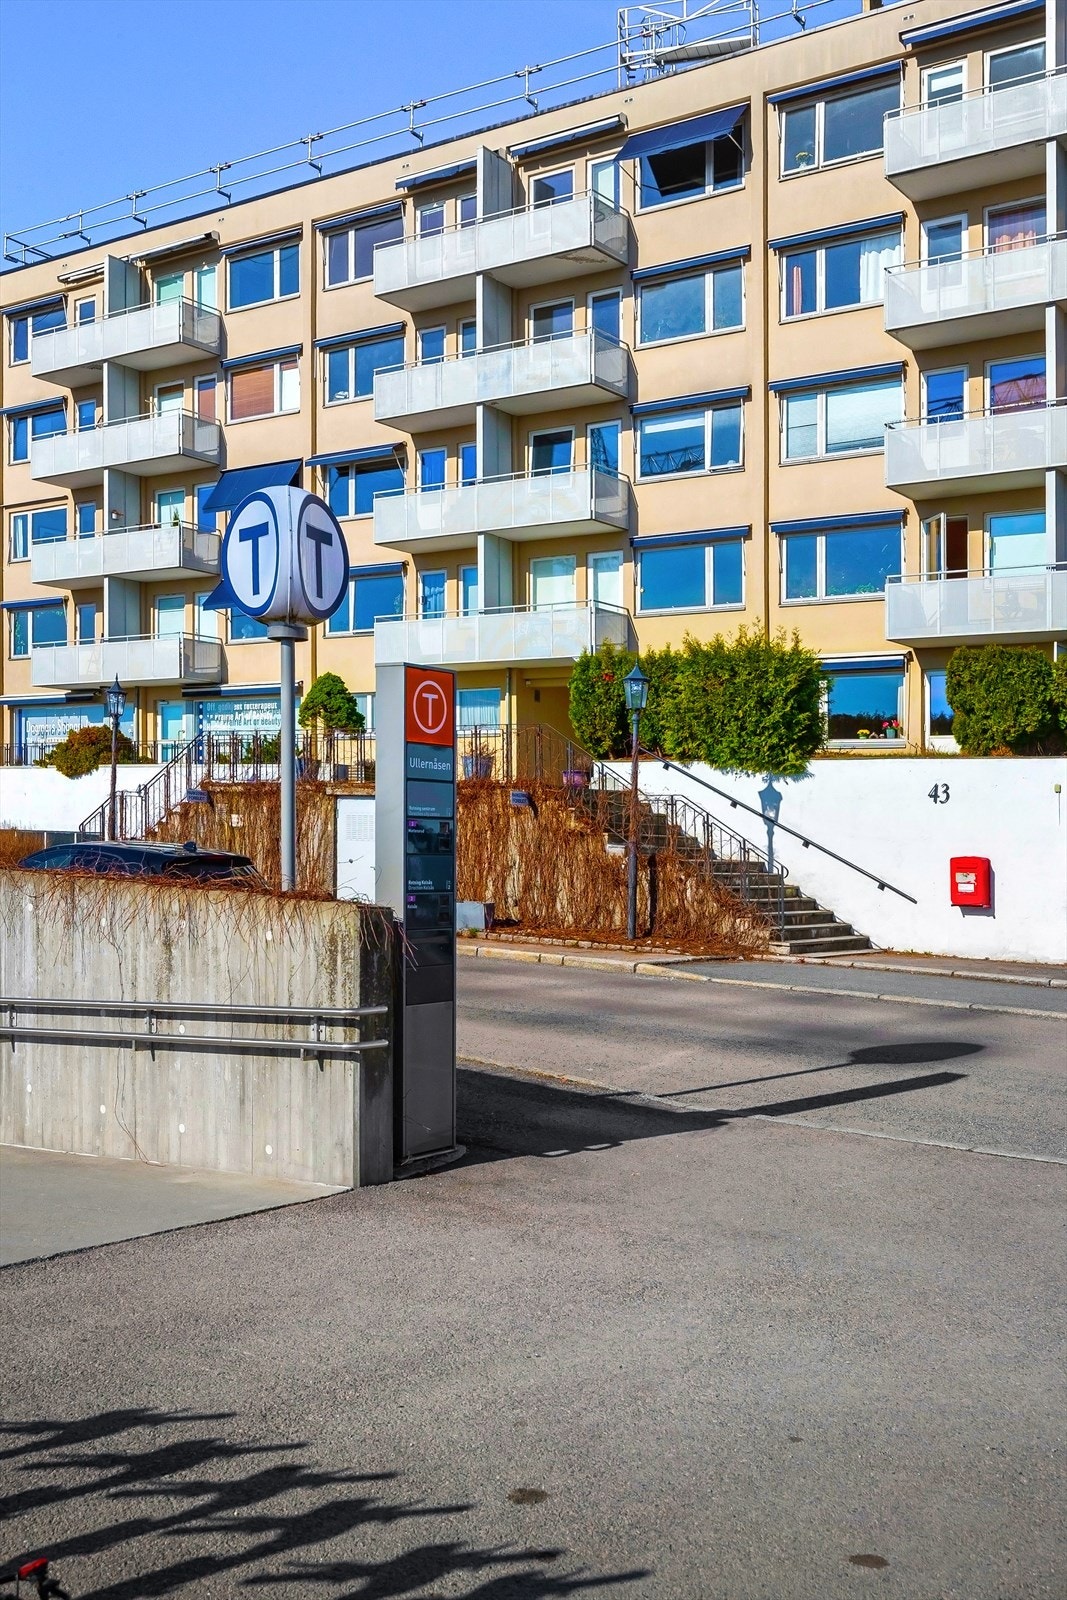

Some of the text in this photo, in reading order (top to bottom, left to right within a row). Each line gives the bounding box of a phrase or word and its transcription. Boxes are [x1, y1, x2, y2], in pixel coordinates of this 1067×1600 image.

[239, 521, 269, 596] T
[306, 522, 333, 599] T
[422, 693, 439, 727] T
[409, 757, 451, 771] Ullernåsen
[927, 783, 950, 804] 43
